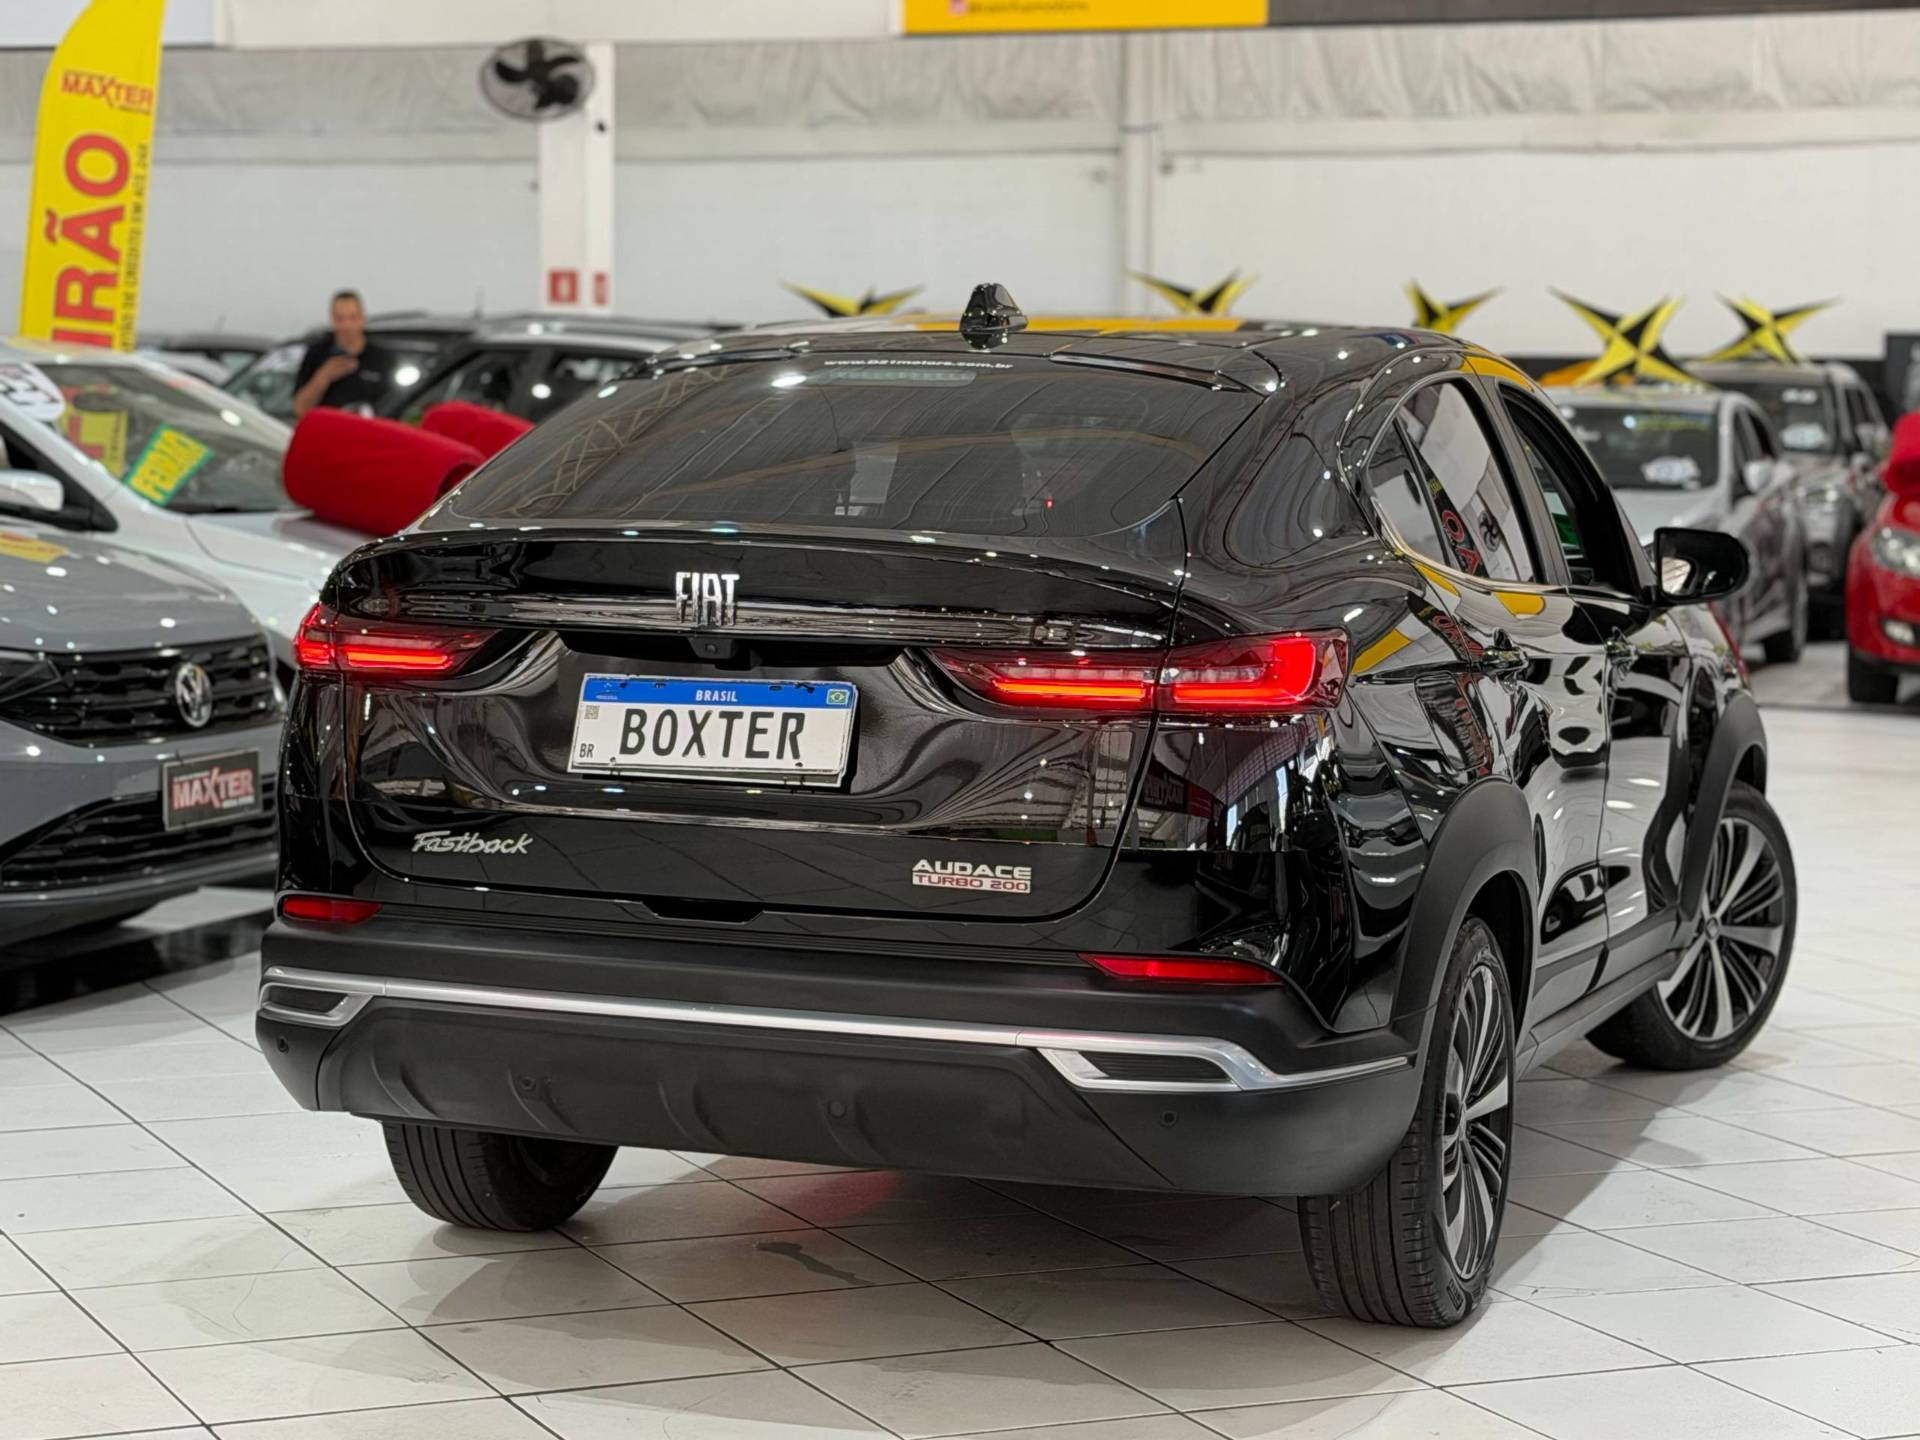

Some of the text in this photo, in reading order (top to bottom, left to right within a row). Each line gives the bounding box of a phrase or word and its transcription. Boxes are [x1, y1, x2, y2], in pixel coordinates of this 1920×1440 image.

[61, 69, 152, 111] MAXTER
[675, 571, 740, 626] FIAT
[695, 689, 738, 702] BRASIL
[619, 708, 806, 760] BOXTER
[579, 743, 595, 758] BR
[172, 767, 255, 810] MAXTER
[411, 830, 534, 854] Fastback
[912, 859, 1032, 880] AUDACE
[914, 874, 1028, 892] TURBO 200
